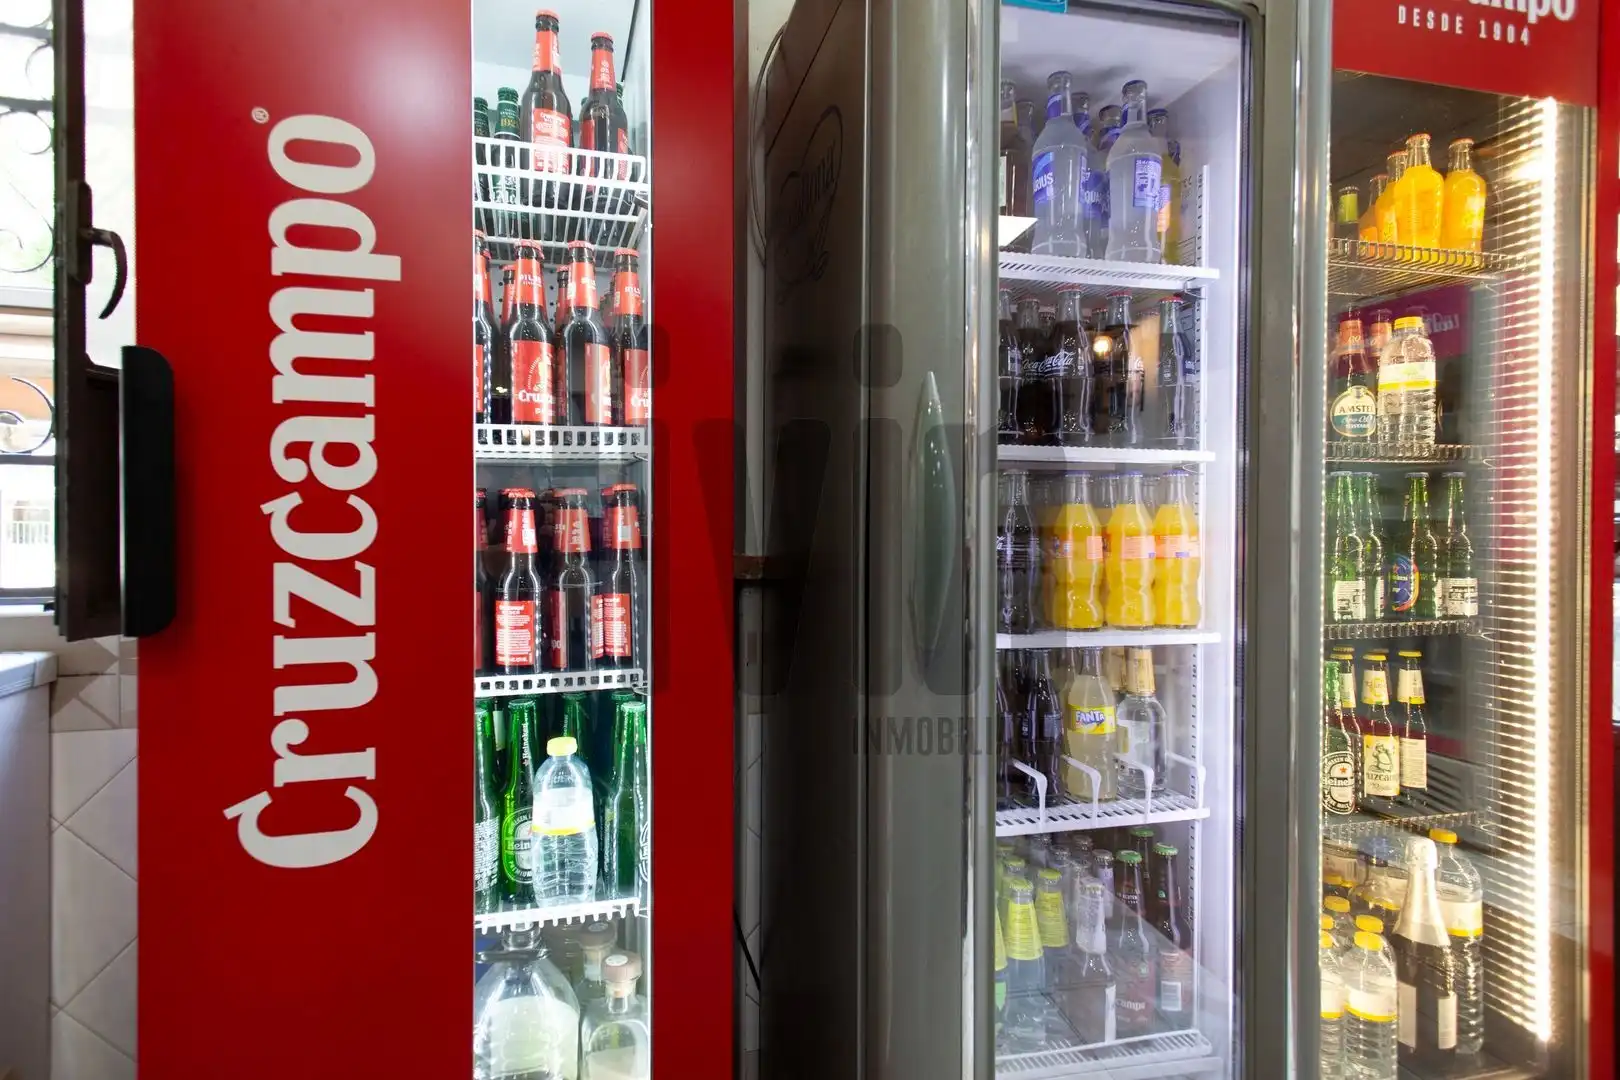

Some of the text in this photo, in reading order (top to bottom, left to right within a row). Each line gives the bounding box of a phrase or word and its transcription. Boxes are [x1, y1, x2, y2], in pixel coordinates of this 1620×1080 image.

[1397, 5, 1530, 46] DESDE 1904
[223, 113, 401, 869] Cruzcampo
[1075, 710, 1105, 724] FANTA
